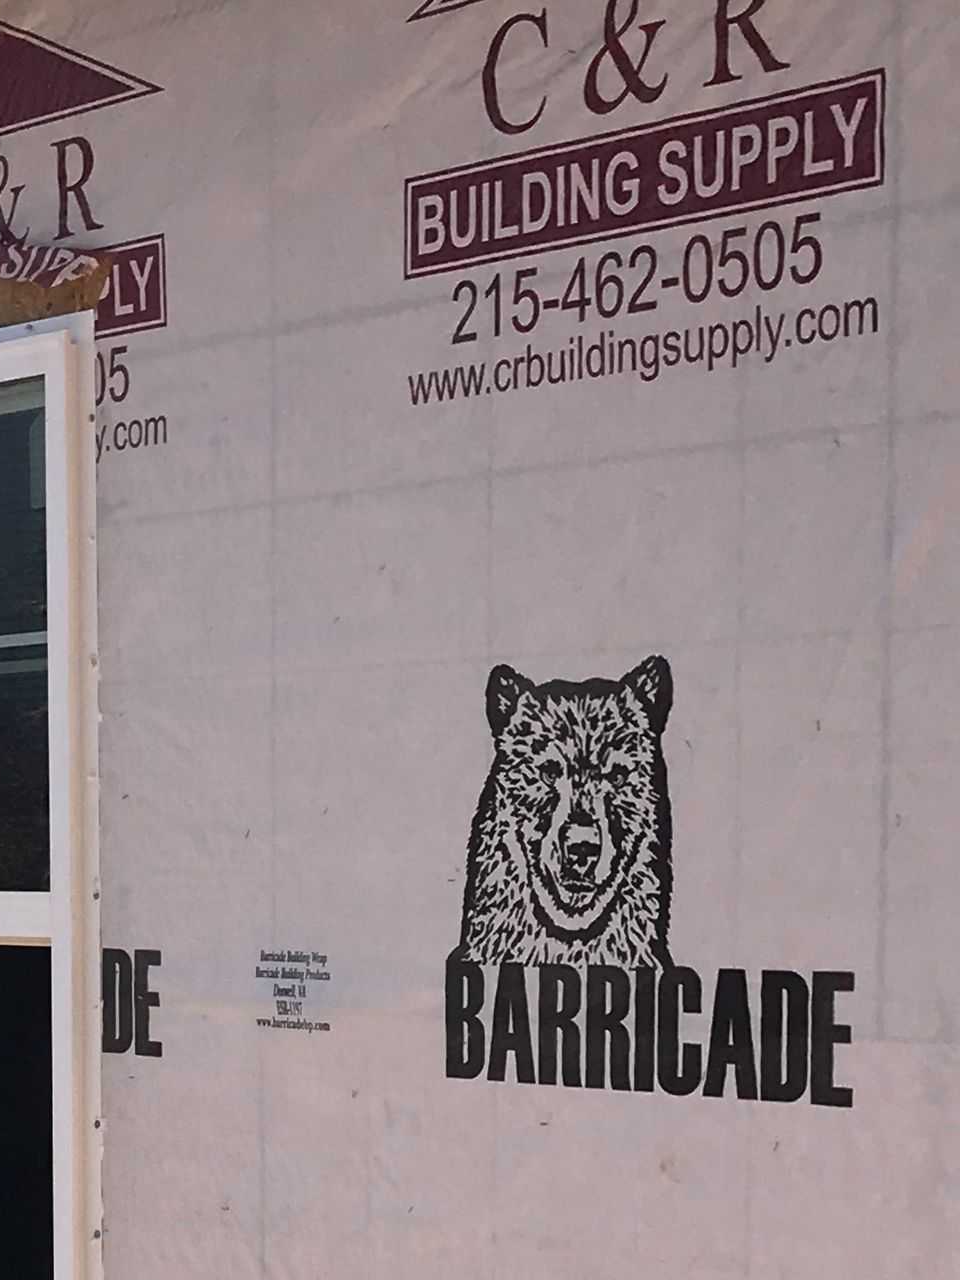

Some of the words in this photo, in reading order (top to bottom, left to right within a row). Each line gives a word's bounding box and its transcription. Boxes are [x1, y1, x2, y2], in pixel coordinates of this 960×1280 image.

[481, 8, 548, 134] C
[583, 0, 668, 115] &
[51, 136, 104, 240] R
[417, 151, 640, 256] BUILDING
[657, 98, 867, 206] SUPPLY
[452, 212, 823, 344] 215-462-0505
[408, 297, 879, 405] www.crbuildingsupply.com
[446, 959, 854, 1108] BARRICADE
